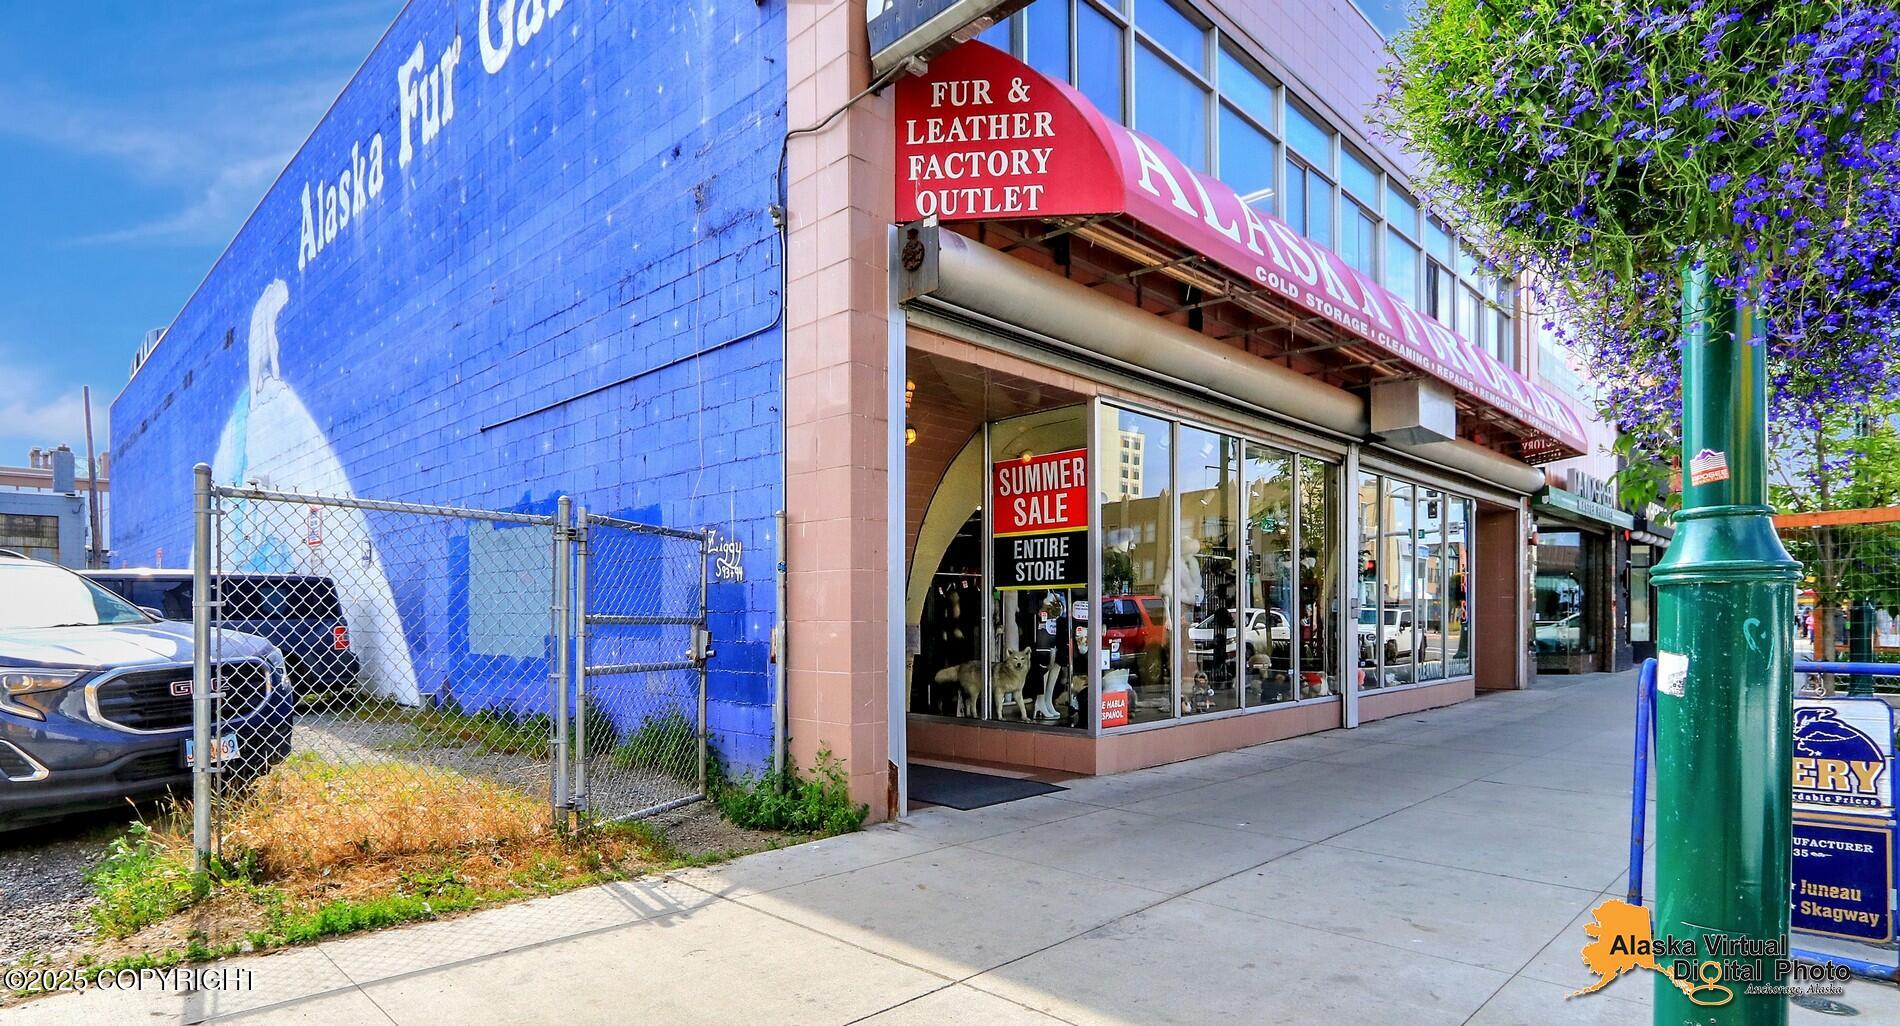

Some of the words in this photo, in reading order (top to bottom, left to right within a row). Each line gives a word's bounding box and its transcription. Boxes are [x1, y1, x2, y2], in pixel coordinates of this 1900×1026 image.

[931, 79, 993, 107] FUR
[1008, 77, 1031, 103] &
[298, 133, 384, 271] Alaska
[398, 35, 462, 168] Fur
[479, 0, 566, 74] Ga
[906, 112, 1055, 145] LEATHER
[908, 148, 1054, 181] FACTORY
[916, 185, 1044, 216] OUTLET
[1127, 131, 1392, 330] ALASKA
[1256, 266, 1299, 299] COLD
[1306, 292, 1368, 336] STORAGE
[1378, 332, 1430, 370] CLEANING
[1437, 365, 1474, 393] REPAIRS
[1480, 387, 1524, 417] REMODELING
[1000, 457, 1086, 496] SUMMER
[1014, 493, 1069, 527] SALE
[707, 529, 742, 577] Ziggy
[1014, 536, 1069, 559] ENTIRE
[1015, 560, 1066, 582] STORE
[171, 676, 230, 696] GC
[1101, 709, 1124, 721] SPAÑOL
[1106, 699, 1125, 710] HABLA
[1792, 757, 1884, 793] ERY
[1792, 793, 1831, 803] rdable
[1835, 796, 1877, 806] Prices
[1792, 837, 1874, 854] UFACTURER
[1793, 849, 1809, 858] 35
[1800, 879, 1862, 902] Juneau
[1800, 900, 1880, 928] Skagway
